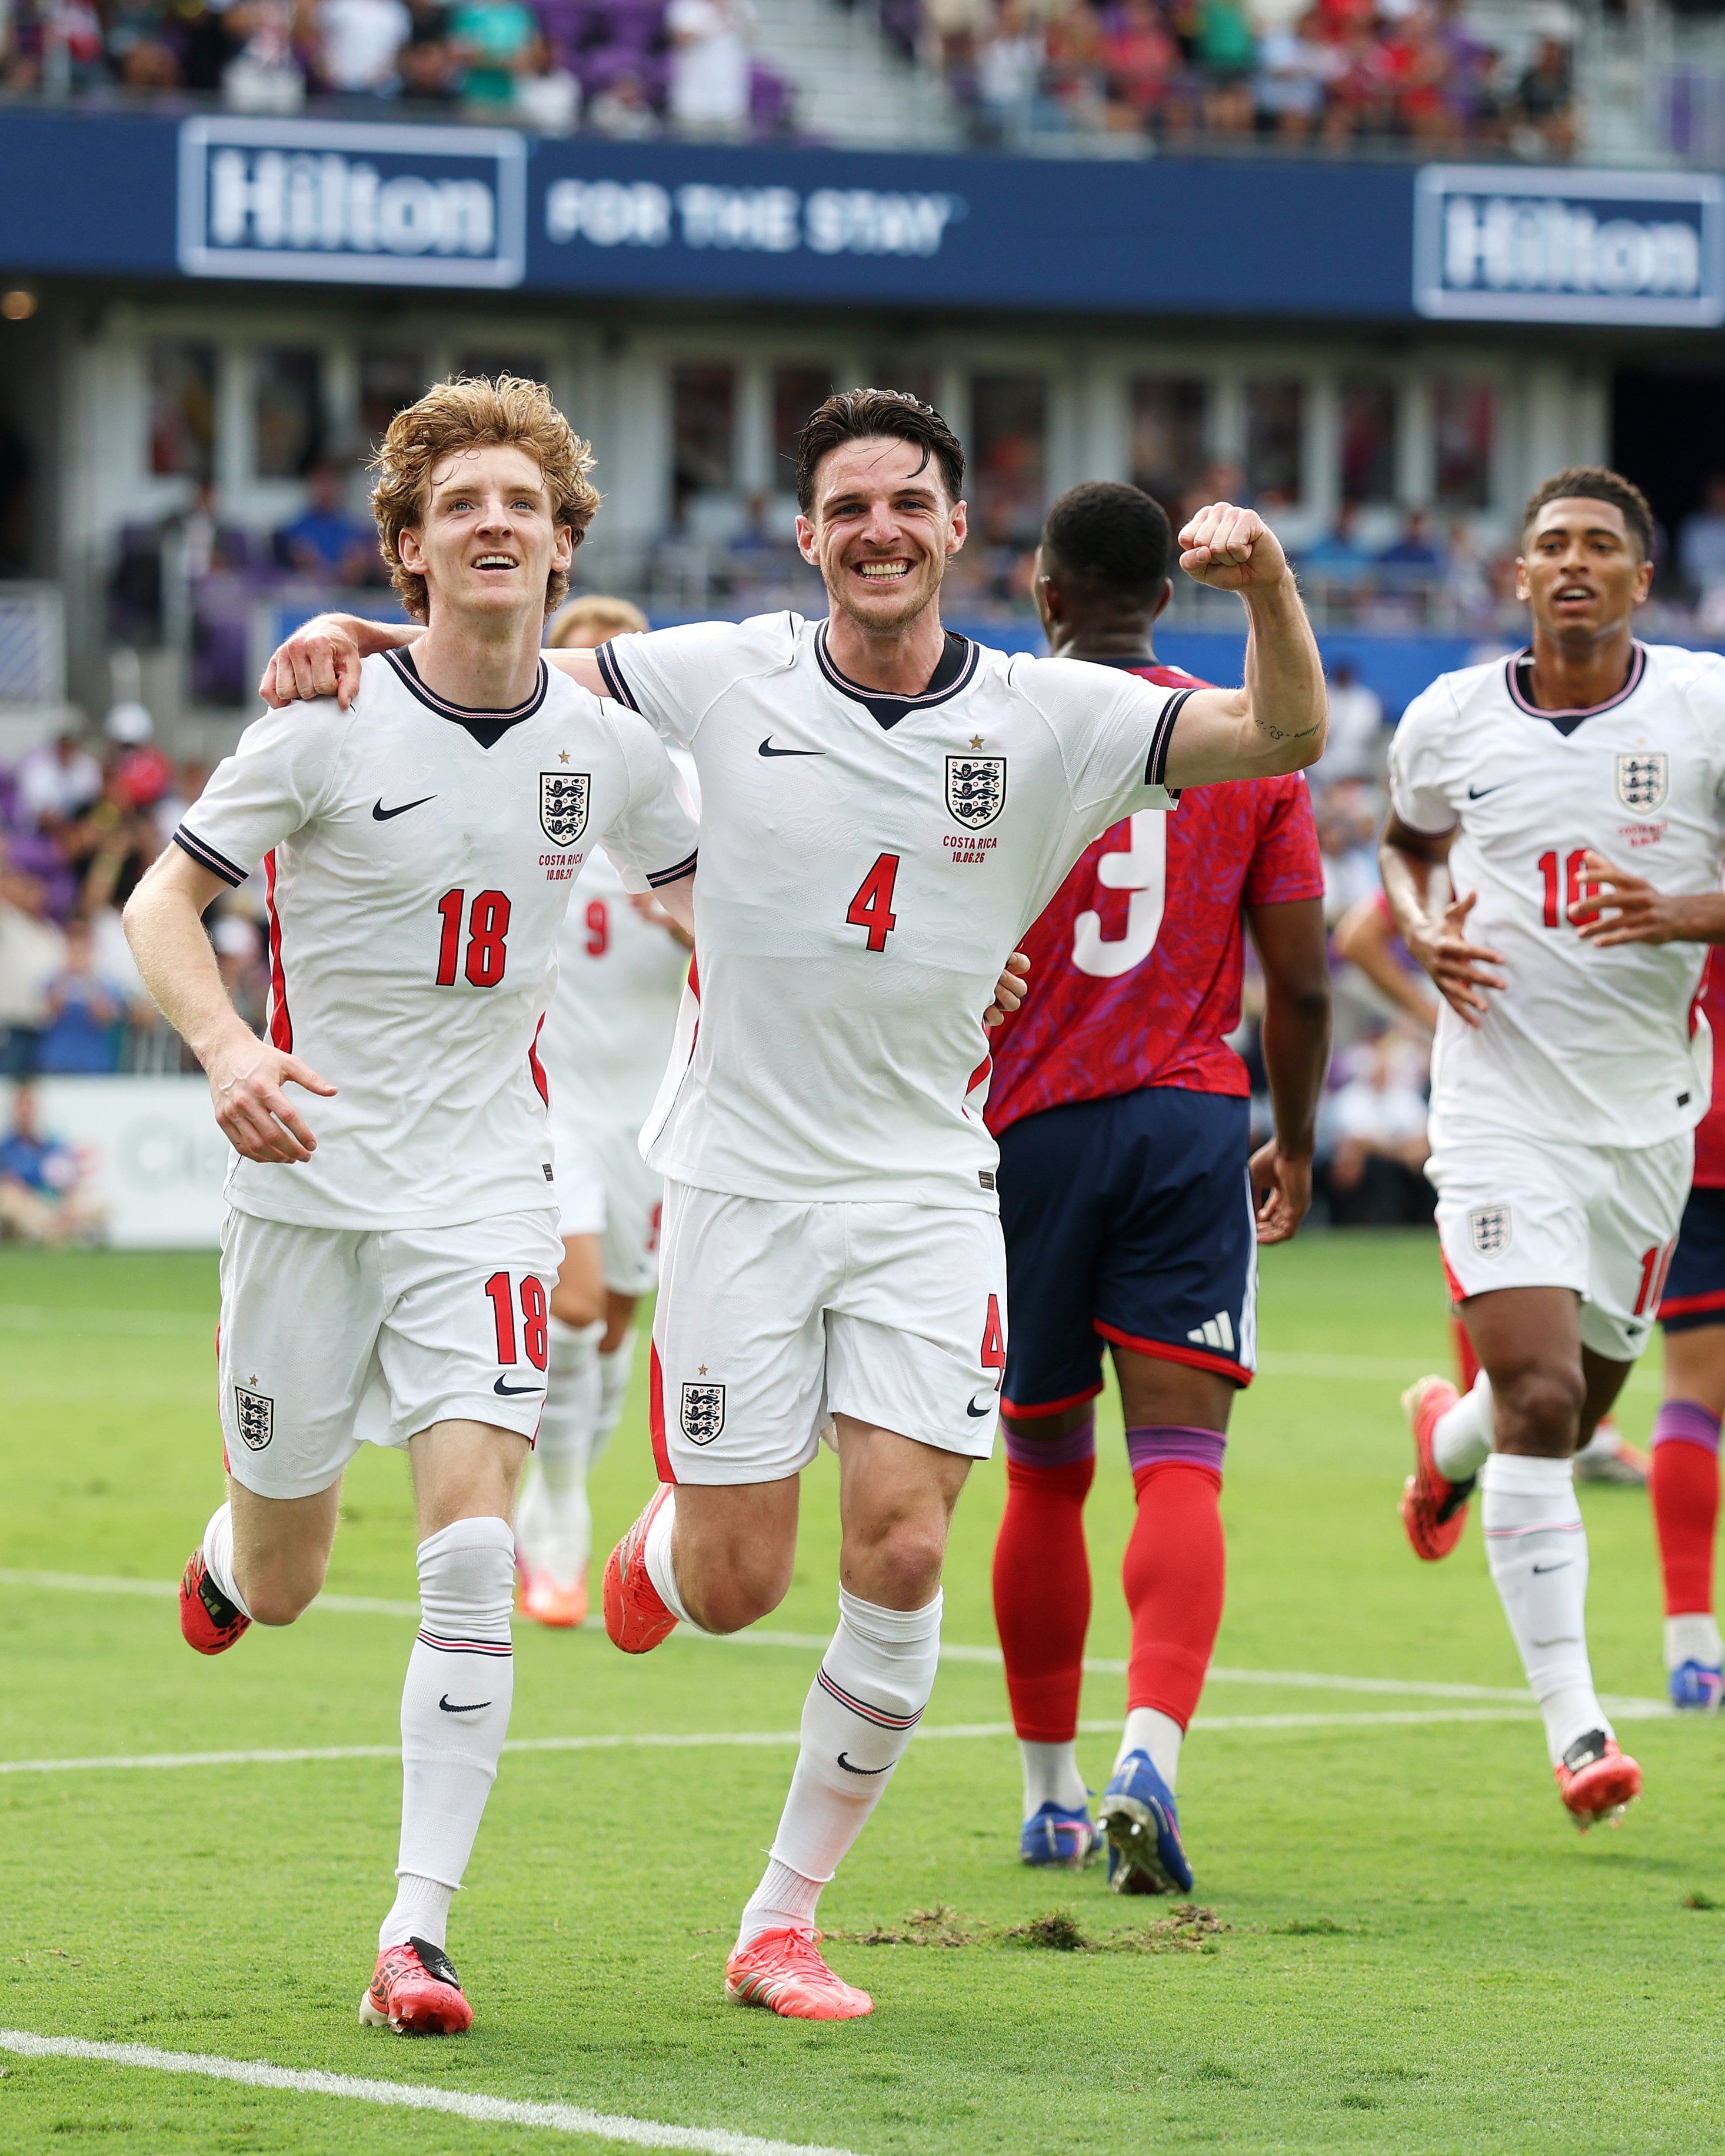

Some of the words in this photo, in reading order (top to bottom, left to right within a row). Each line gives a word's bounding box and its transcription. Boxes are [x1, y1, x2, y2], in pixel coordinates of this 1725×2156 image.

[211, 149, 494, 255] Hilton
[545, 178, 672, 248] FOR
[675, 182, 801, 252] THE
[803, 186, 948, 257] STAY
[1445, 196, 1699, 295] Hilton
[539, 854, 565, 865] COSTA
[567, 853, 583, 865] RICA
[547, 868, 573, 881] 10.06.26
[943, 835, 975, 849] COSTA
[977, 838, 997, 848] RICA
[952, 851, 985, 863] 10.06.26
[585, 899, 608, 957] 9
[845, 852, 900, 952] 4
[1538, 850, 1599, 927] 10
[436, 889, 511, 988] 18
[485, 1271, 548, 1372] 18
[981, 1294, 1005, 1391] 4
